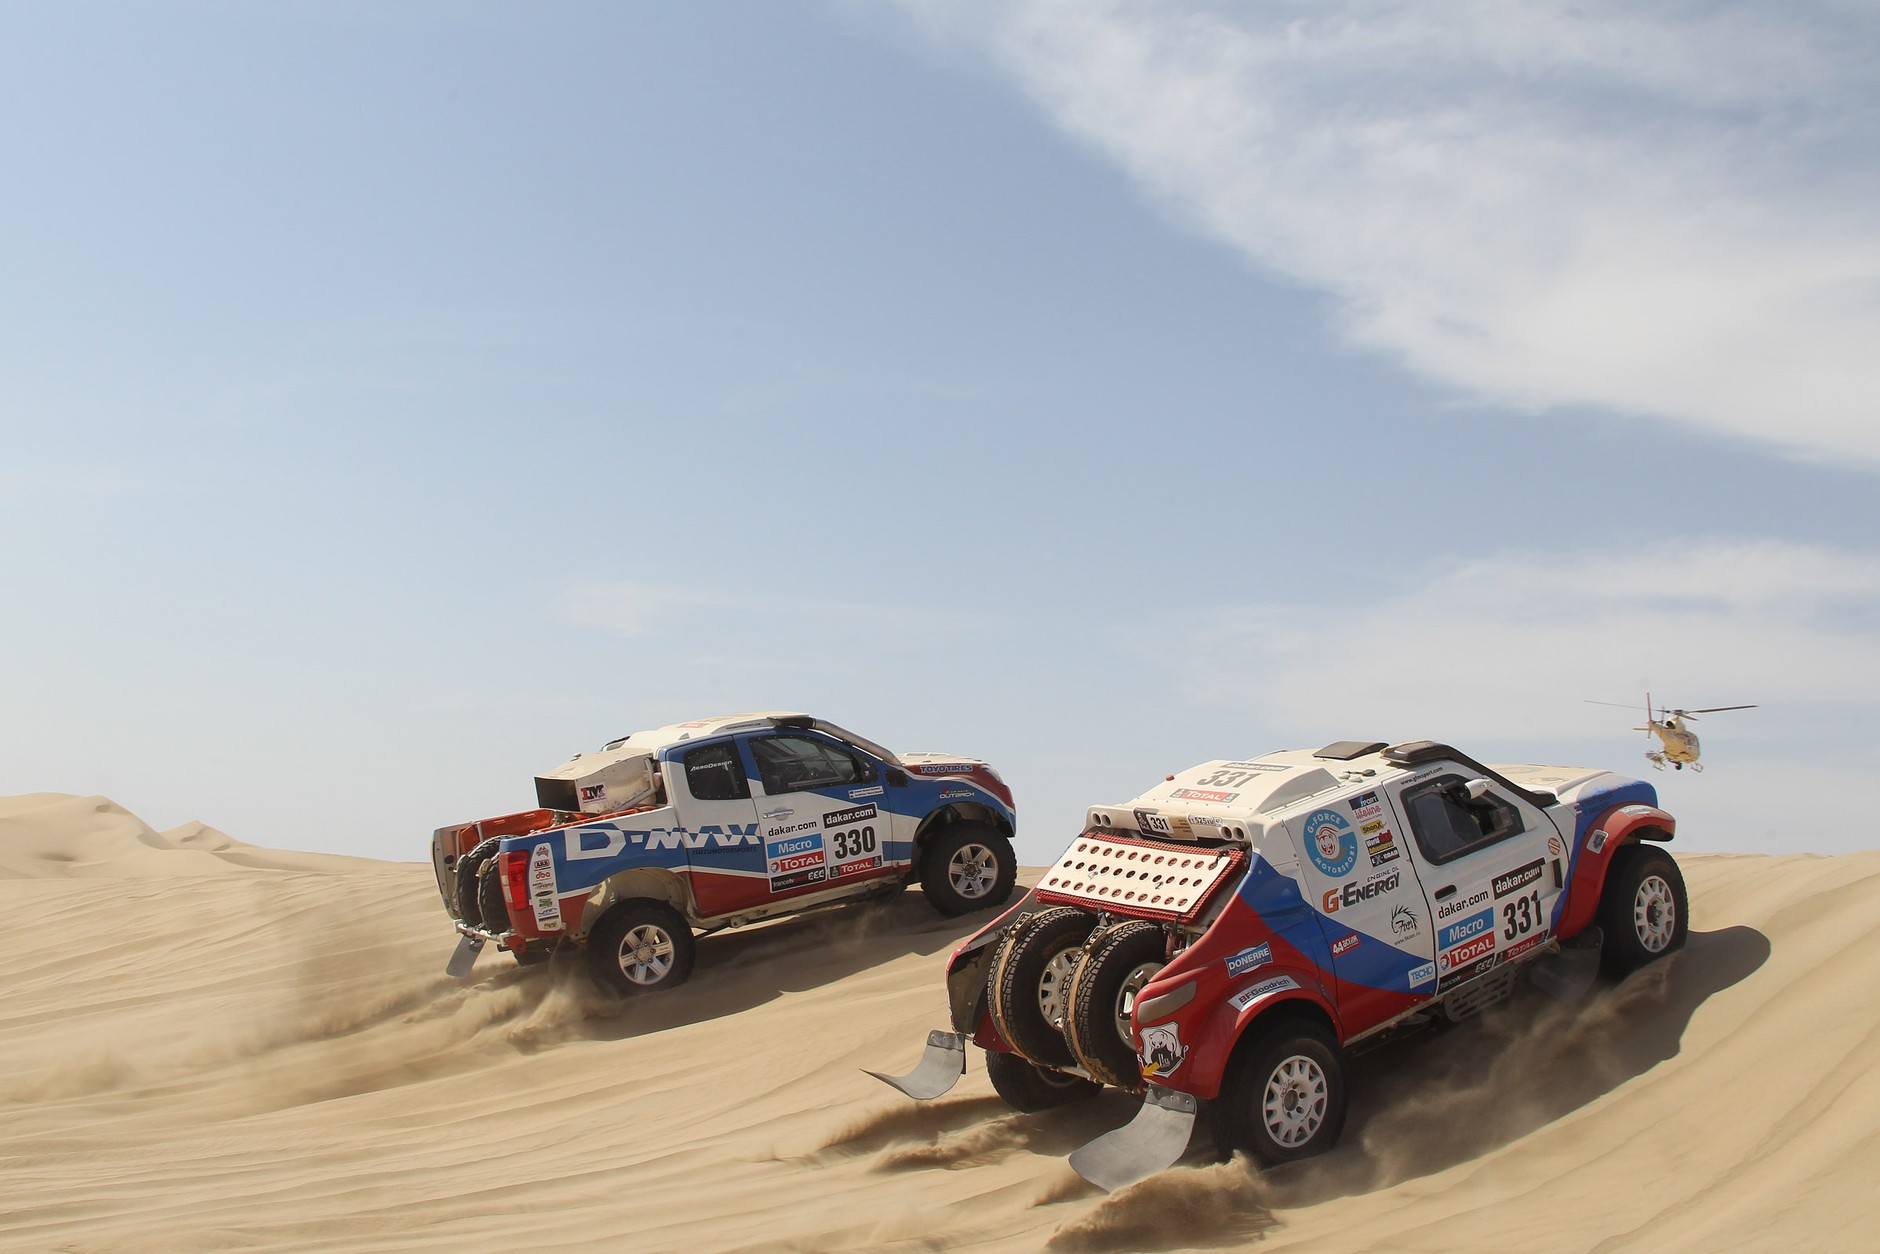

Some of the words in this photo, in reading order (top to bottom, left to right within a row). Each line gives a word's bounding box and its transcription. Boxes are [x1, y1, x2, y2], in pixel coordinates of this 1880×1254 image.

[946, 764, 973, 773] TIRES
[1197, 770, 1263, 788] 331
[1186, 790, 1222, 800] TOTAL
[826, 807, 874, 825] dakar.com
[1150, 817, 1170, 831] 331
[1307, 813, 1341, 833] G-FORCE
[768, 820, 817, 837] dakar.com
[778, 840, 812, 854] Macro
[834, 826, 876, 859] 330
[782, 855, 823, 869] TOTAL
[841, 861, 872, 873] TOTAL
[1315, 845, 1356, 874] MOTORSPORT
[1367, 869, 1390, 882] ENGINE
[1495, 866, 1540, 894] dakar.com
[1322, 872, 1400, 913] G-ENERGY
[1438, 889, 1489, 919] dakar.com
[1503, 889, 1543, 941] 331
[1449, 917, 1484, 943] Macro
[1451, 936, 1495, 963] TOTAL
[1507, 940, 1536, 957] TOTAL
[1228, 947, 1270, 970] DONERRE
[1238, 979, 1290, 1004] BFGoodrich
